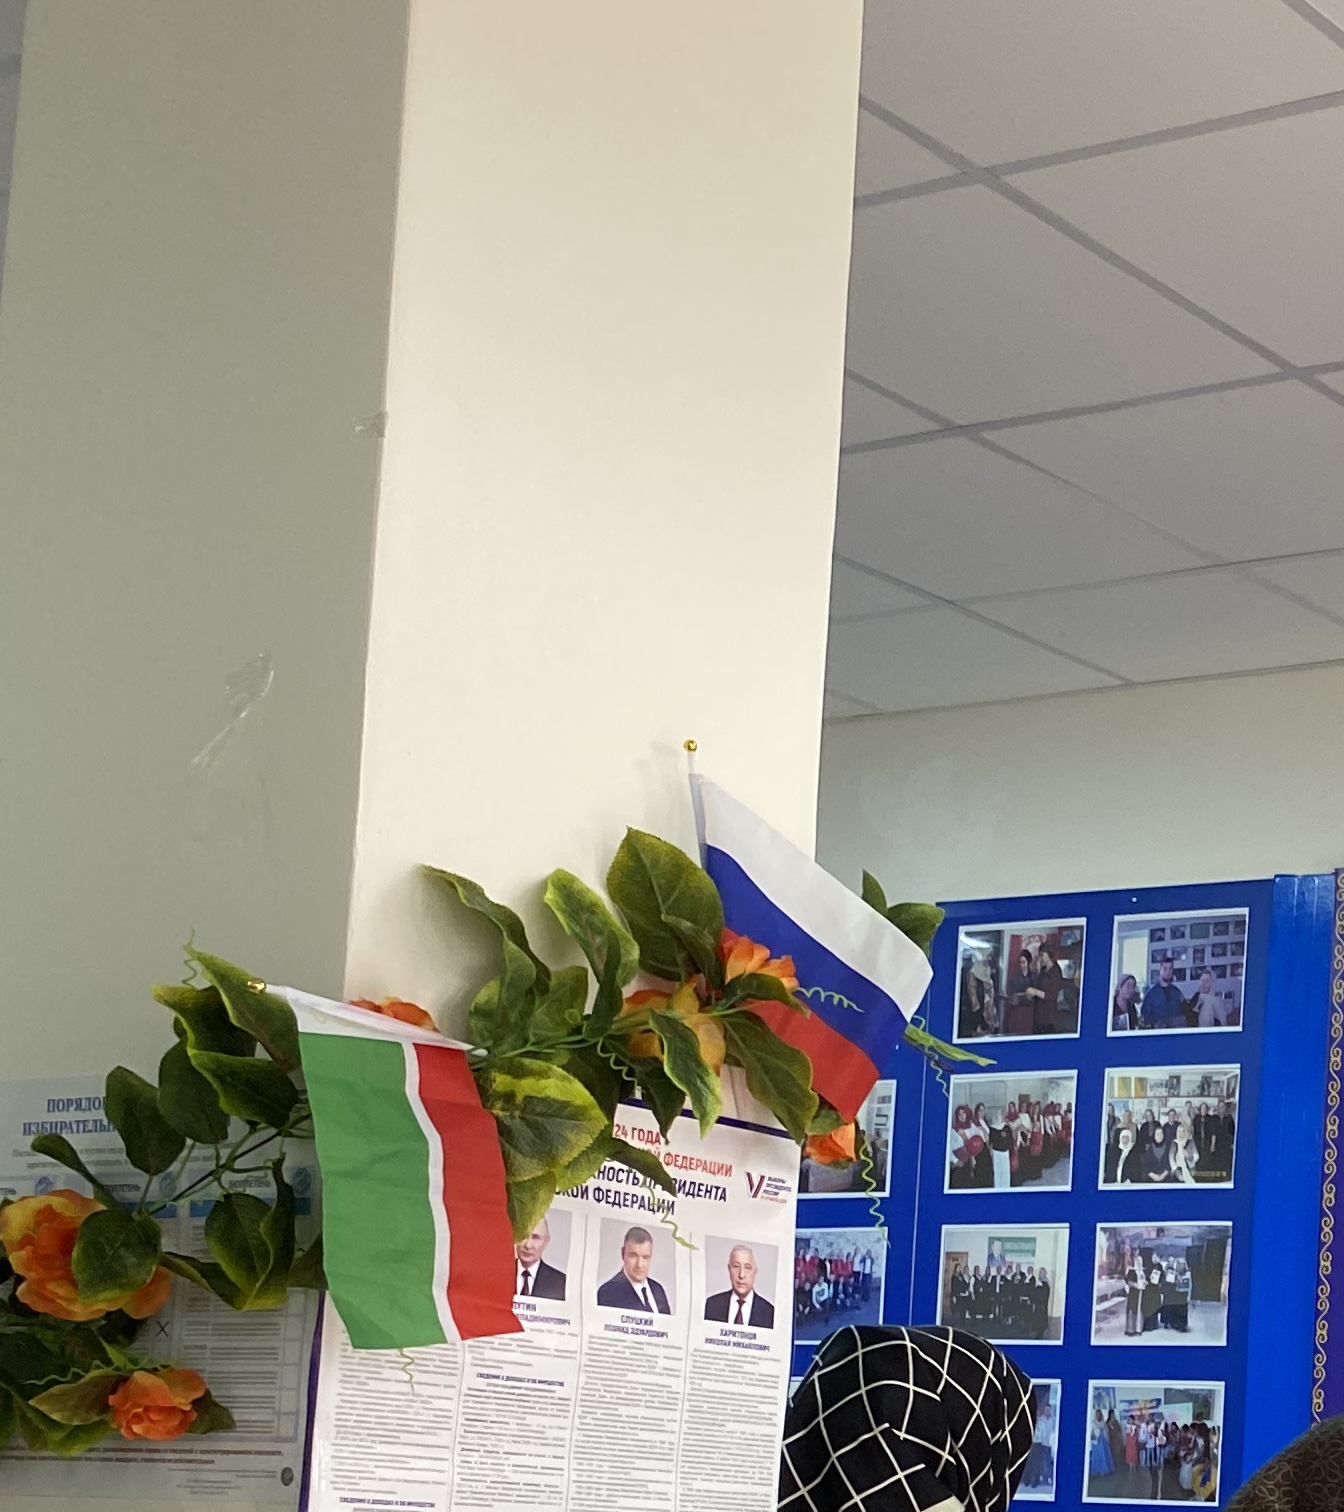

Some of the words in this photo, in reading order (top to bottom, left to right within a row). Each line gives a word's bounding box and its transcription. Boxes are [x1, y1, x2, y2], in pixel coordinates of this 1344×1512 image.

[47, 1096, 105, 1112] ПОРЯДО
[614, 1124, 628, 1139] 24
[632, 1127, 661, 1146] ГОДА
[663, 1152, 733, 1177] ФЕДЕРАЦИИ
[594, 1165, 640, 1187] НОСТЬ
[593, 1186, 676, 1215] ФЕДЕРАЦИИ
